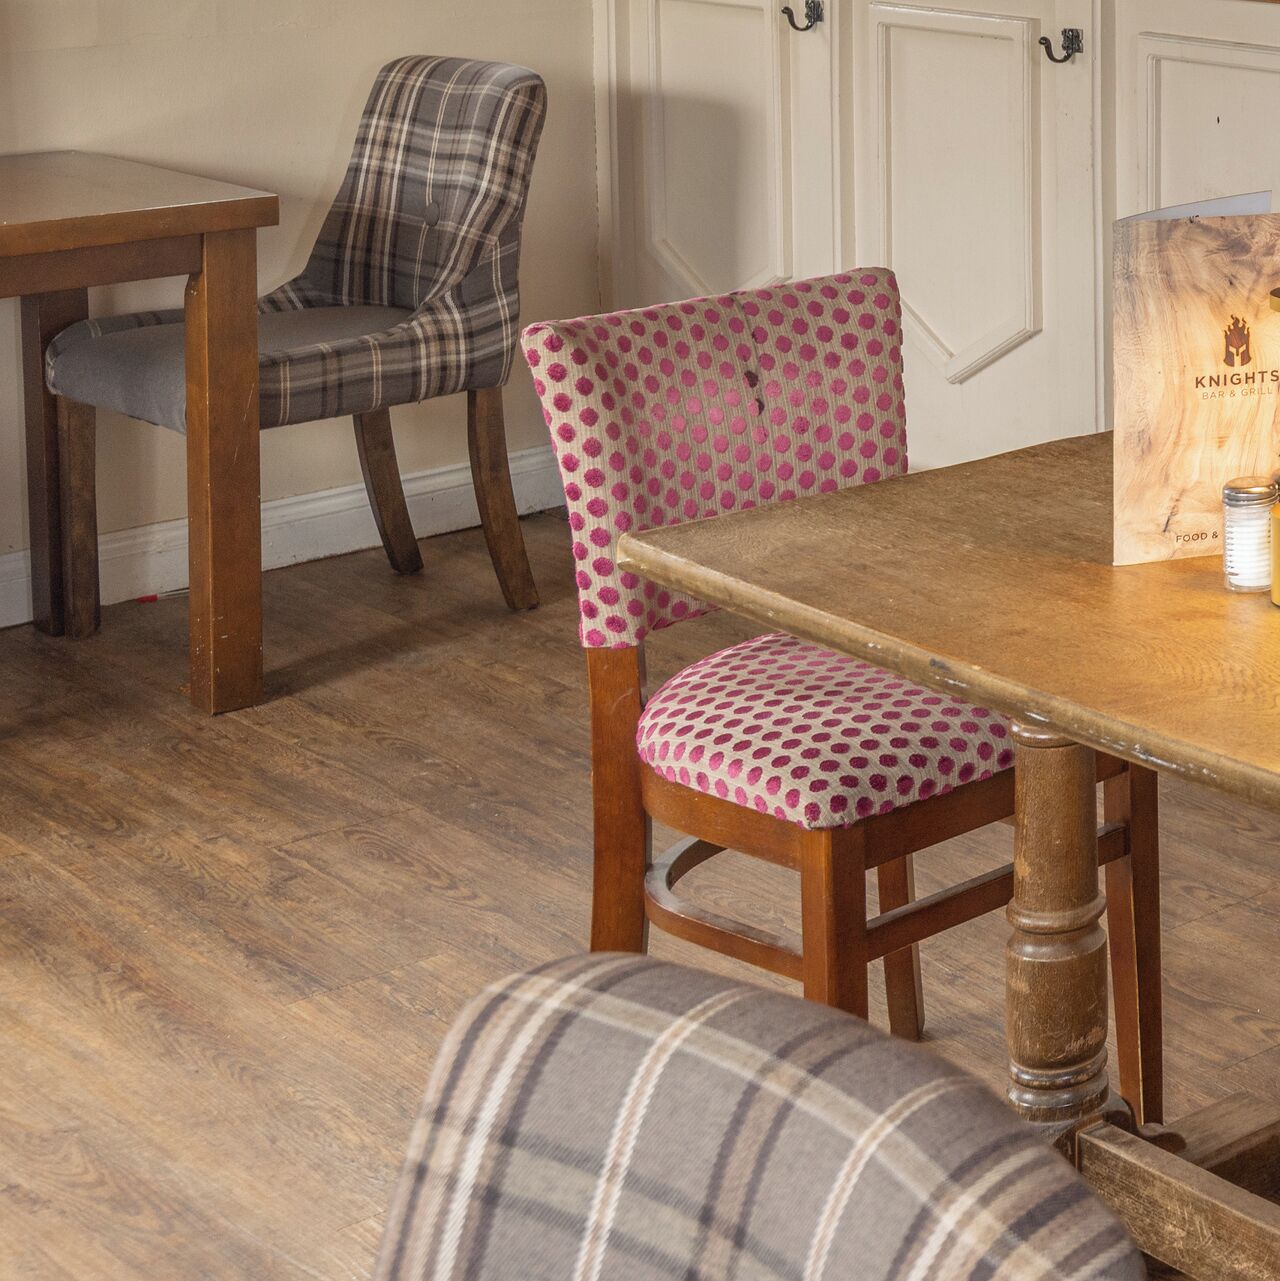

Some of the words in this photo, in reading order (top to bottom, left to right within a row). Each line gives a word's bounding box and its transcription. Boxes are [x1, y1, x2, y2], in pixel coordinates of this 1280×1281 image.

[1195, 370, 1280, 389] KNIGHTS
[1202, 391, 1225, 400] BAR
[1229, 389, 1236, 398] &
[1241, 387, 1273, 396] GRILL
[1176, 532, 1208, 542] FOOD
[1211, 531, 1219, 539] &
